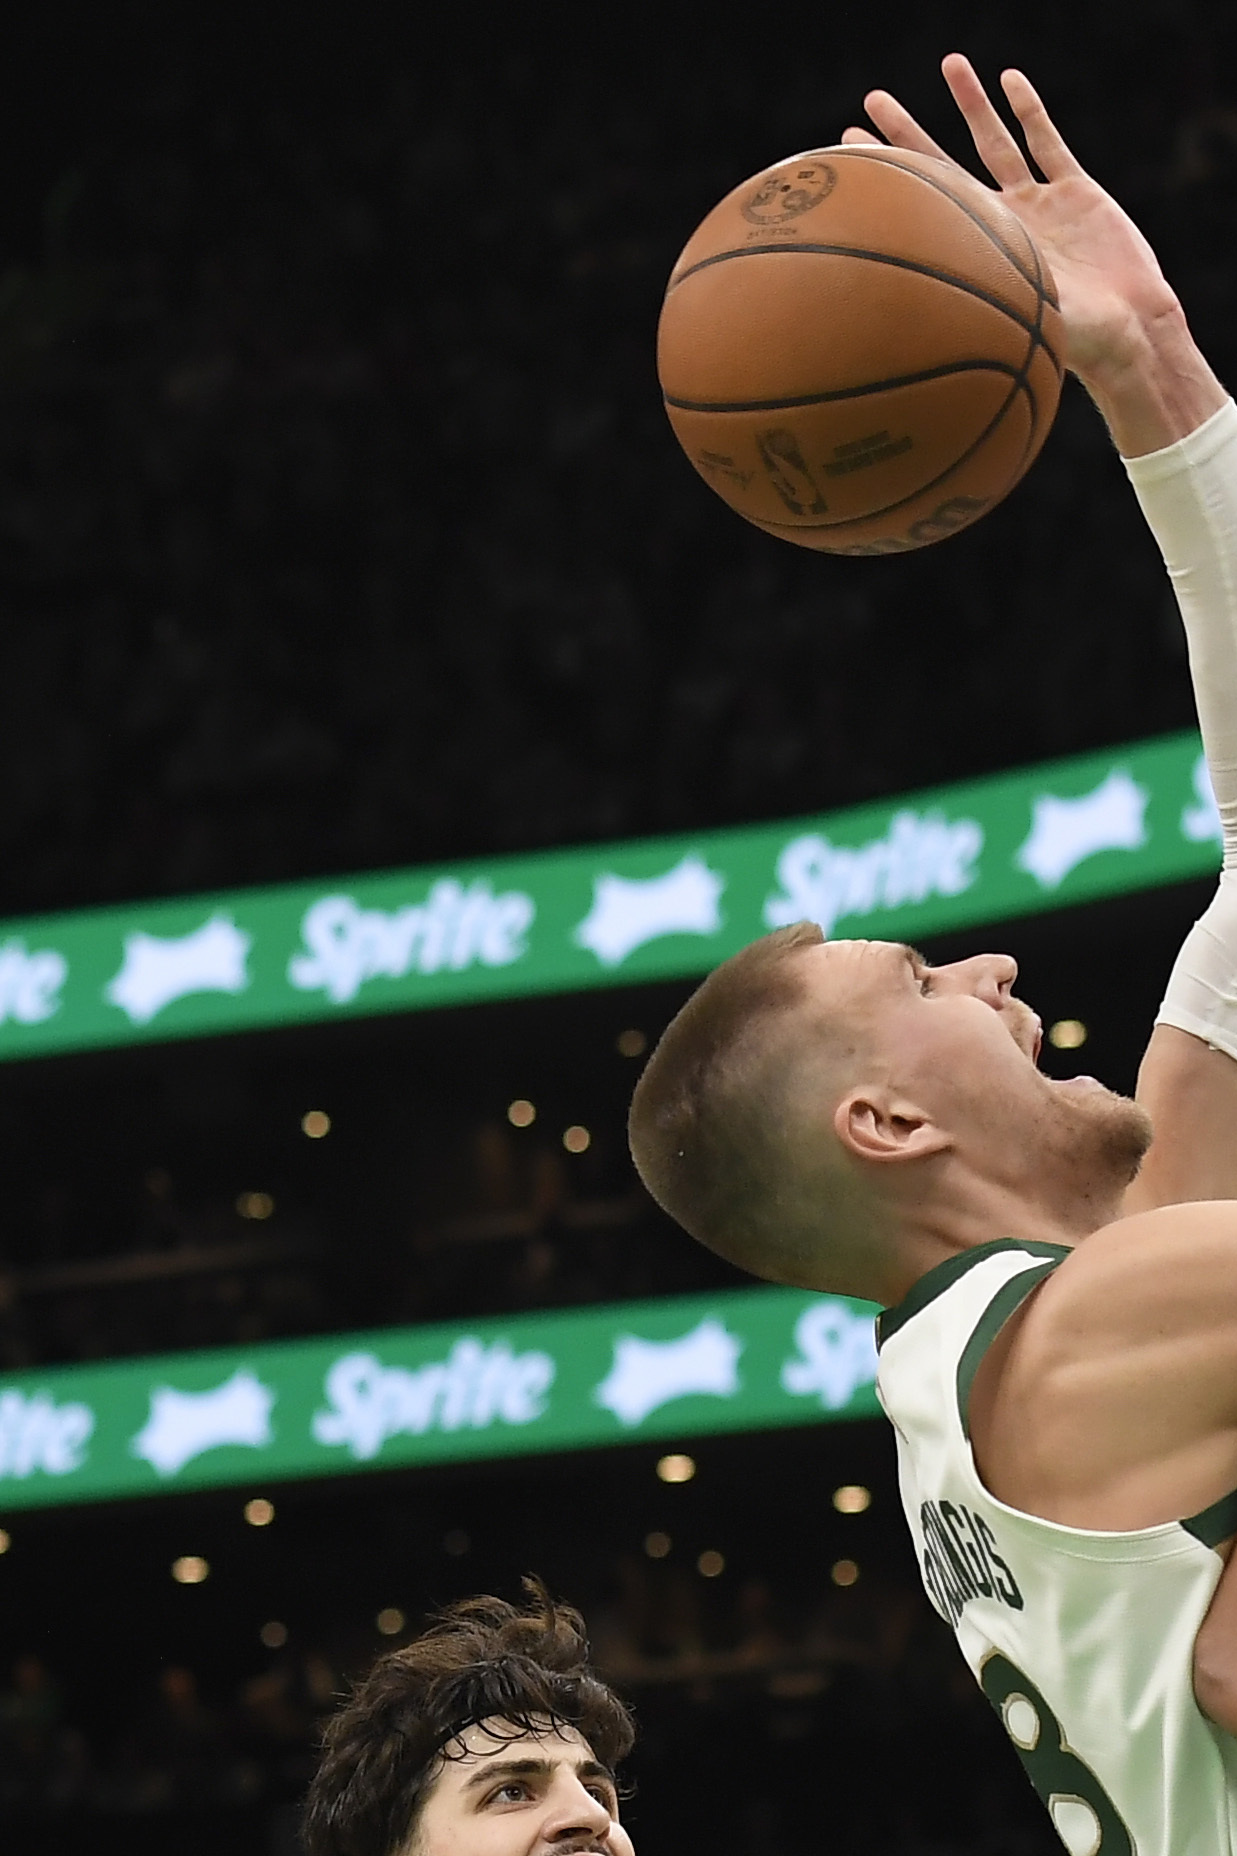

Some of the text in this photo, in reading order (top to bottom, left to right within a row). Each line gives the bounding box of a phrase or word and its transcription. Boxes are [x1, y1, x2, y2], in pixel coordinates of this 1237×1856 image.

[762, 808, 984, 934] Sprite
[288, 877, 536, 1004] Sprite
[311, 1335, 556, 1461] Sprite
